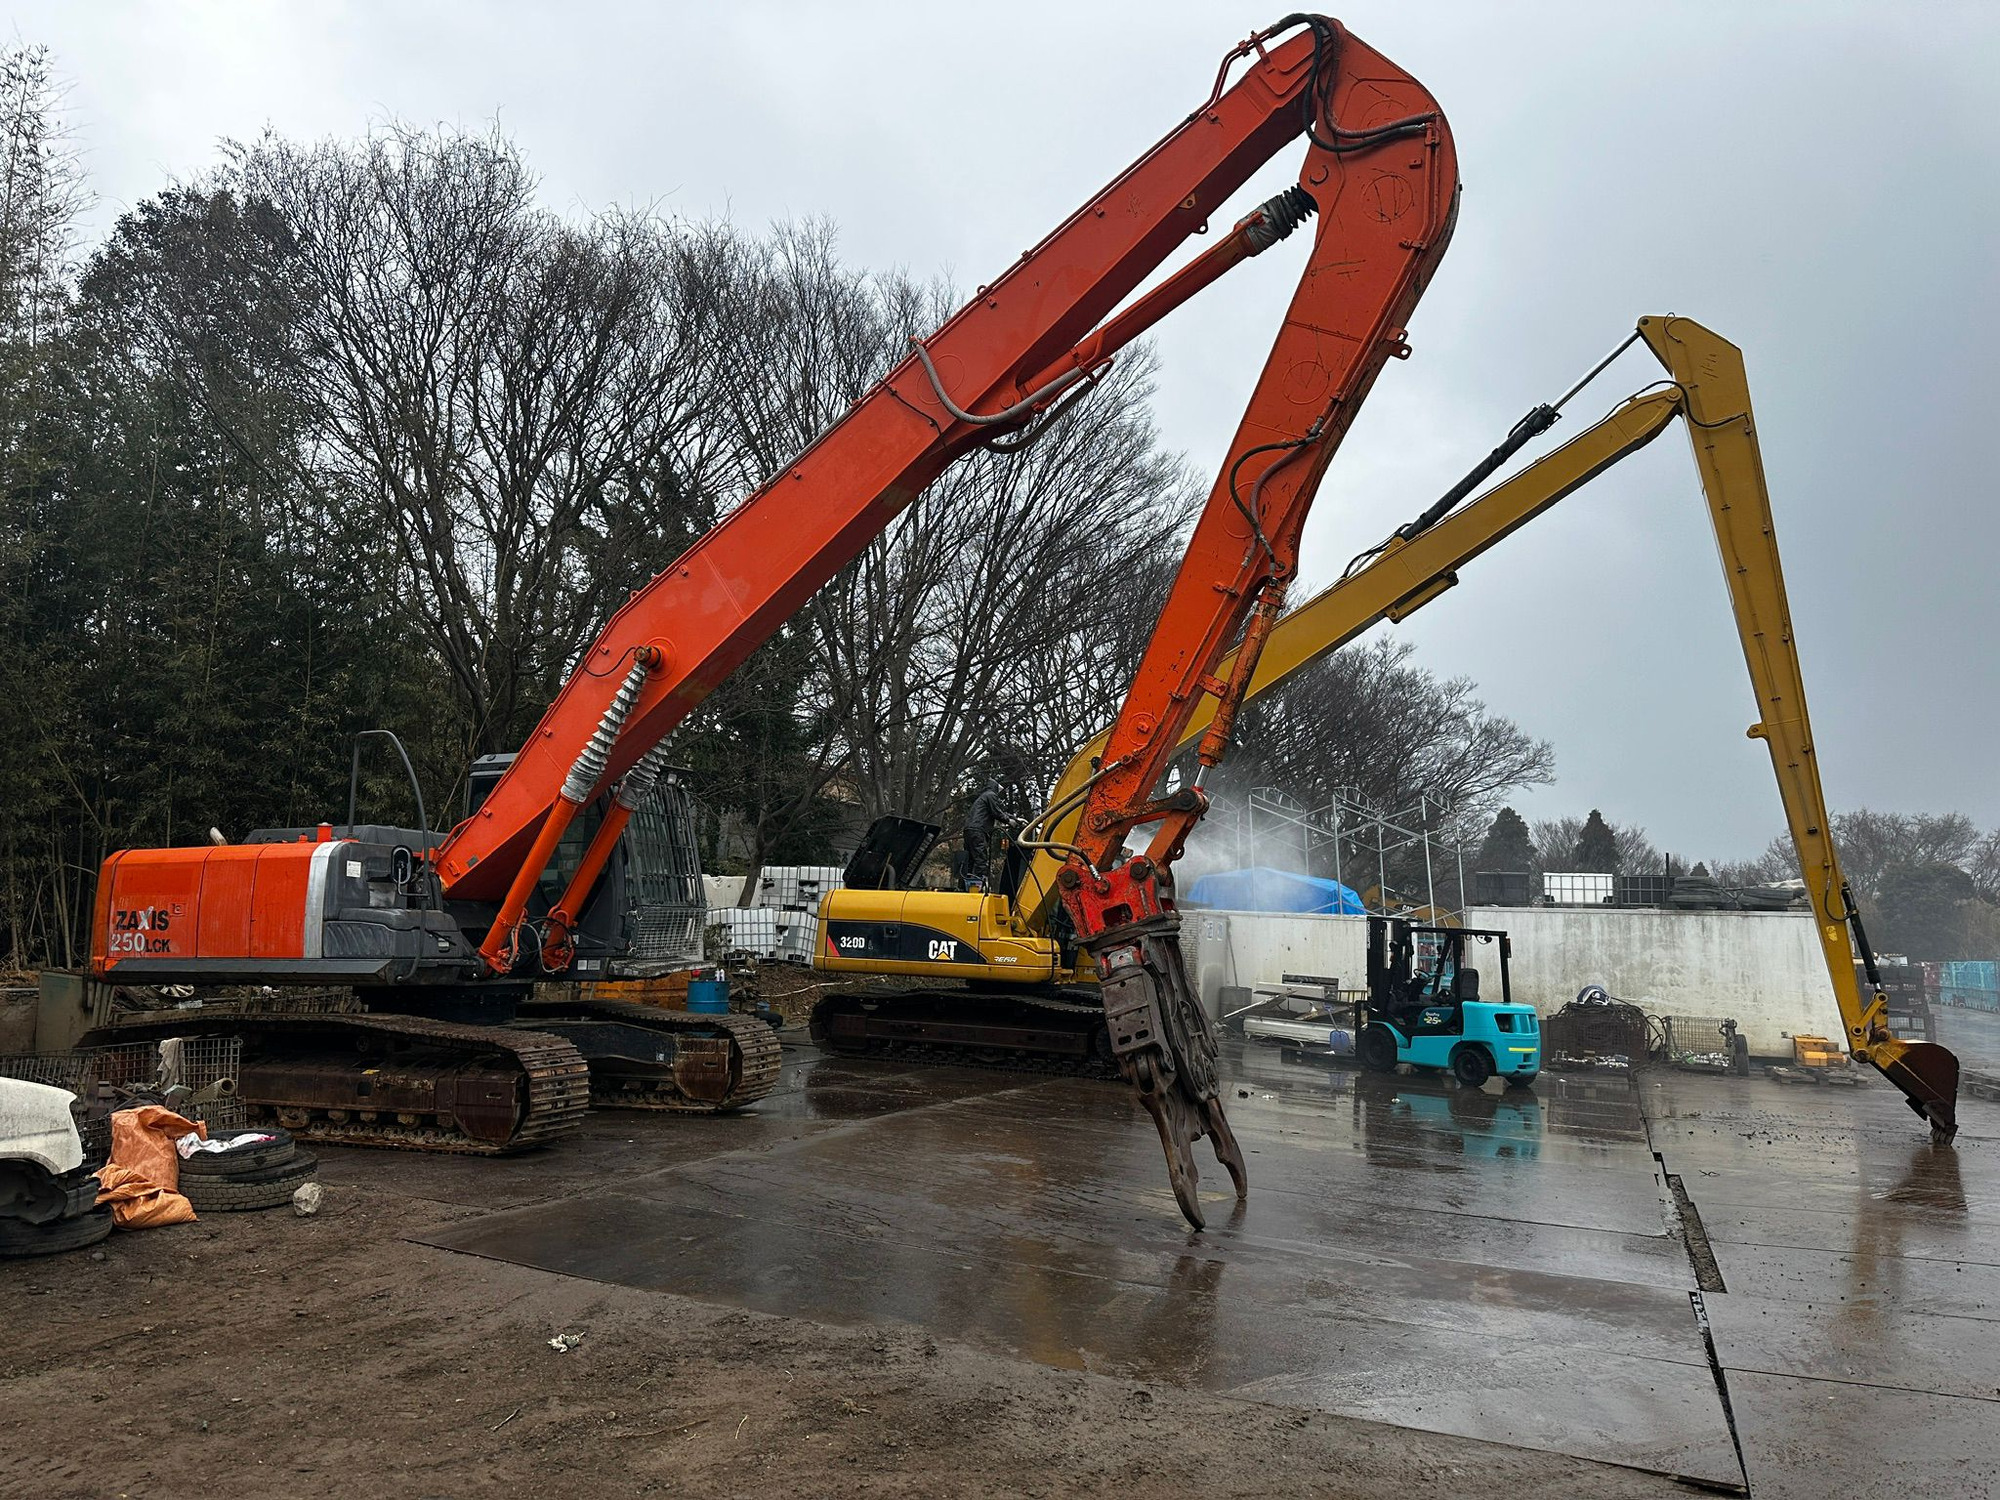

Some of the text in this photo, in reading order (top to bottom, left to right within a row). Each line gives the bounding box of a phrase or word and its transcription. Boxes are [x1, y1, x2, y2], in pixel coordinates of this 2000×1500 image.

[115, 905, 170, 931] ZAXIS
[840, 936, 865, 949] 320D
[928, 939, 958, 960] CAT
